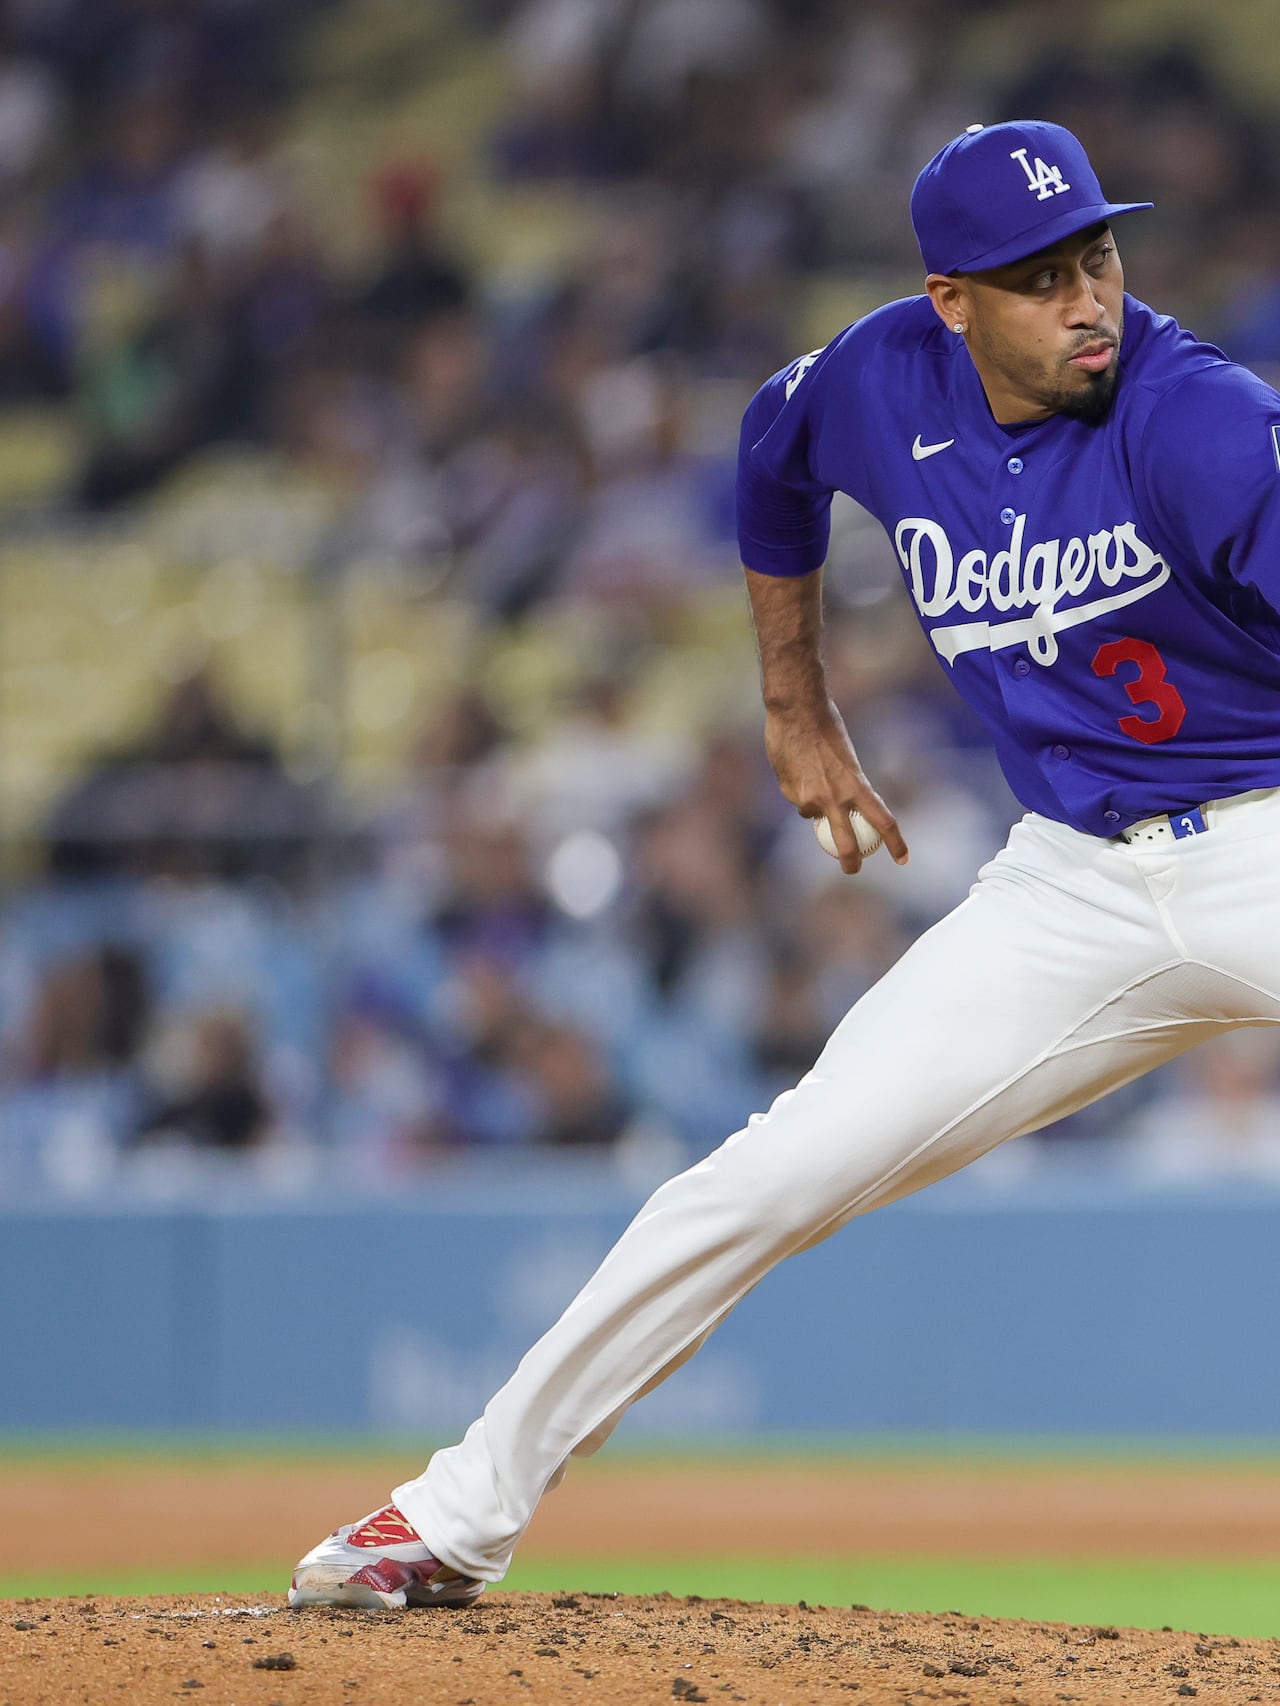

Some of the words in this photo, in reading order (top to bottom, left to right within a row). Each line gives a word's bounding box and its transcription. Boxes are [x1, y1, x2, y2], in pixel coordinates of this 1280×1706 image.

[1009, 147, 1071, 201] LA
[895, 513, 1171, 667] Dodgers
[1091, 636, 1187, 744] 3
[1180, 817, 1198, 837] 3
